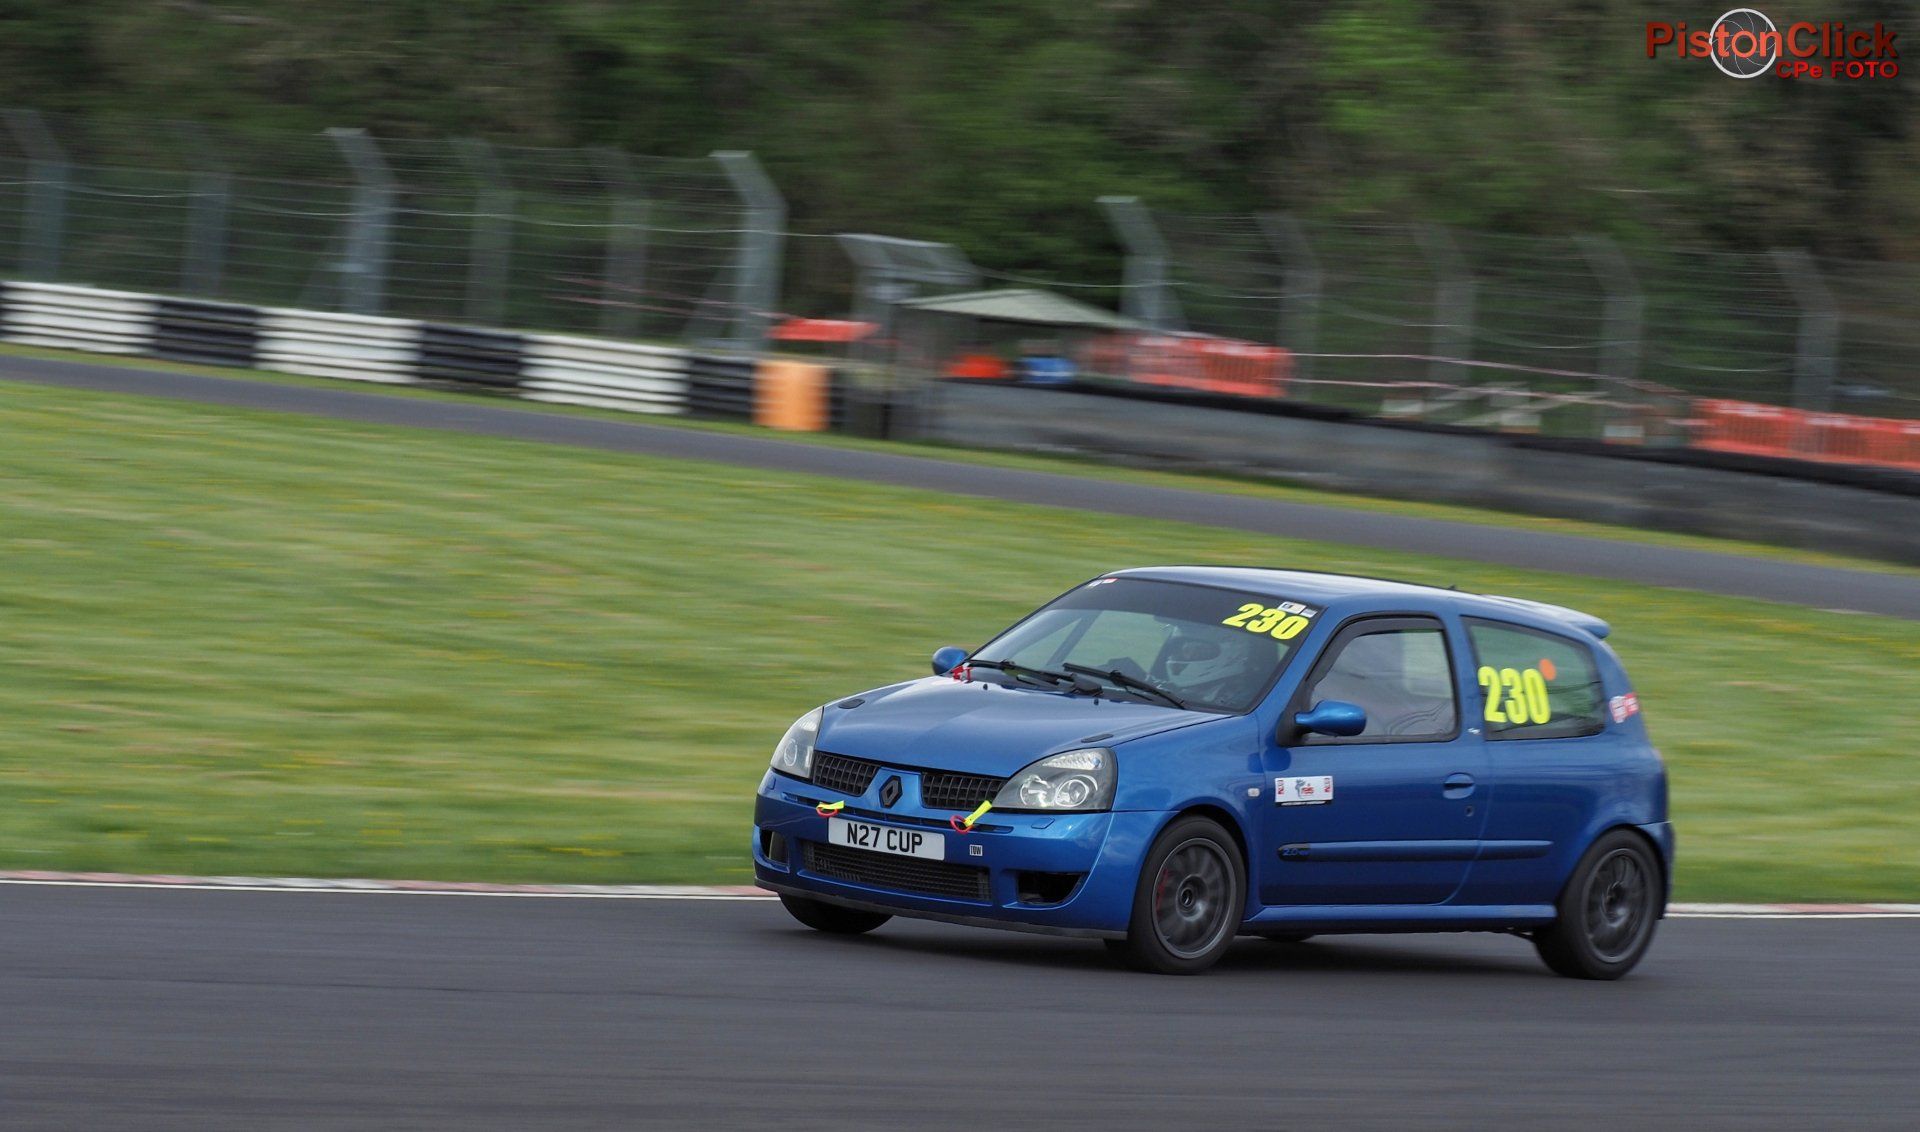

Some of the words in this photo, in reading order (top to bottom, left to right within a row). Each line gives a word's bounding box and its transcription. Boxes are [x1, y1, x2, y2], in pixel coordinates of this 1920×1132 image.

[1222, 603, 1309, 640] 230
[1477, 665, 1551, 724] 230
[847, 822, 880, 848] N27
[887, 829, 923, 853] CUP
